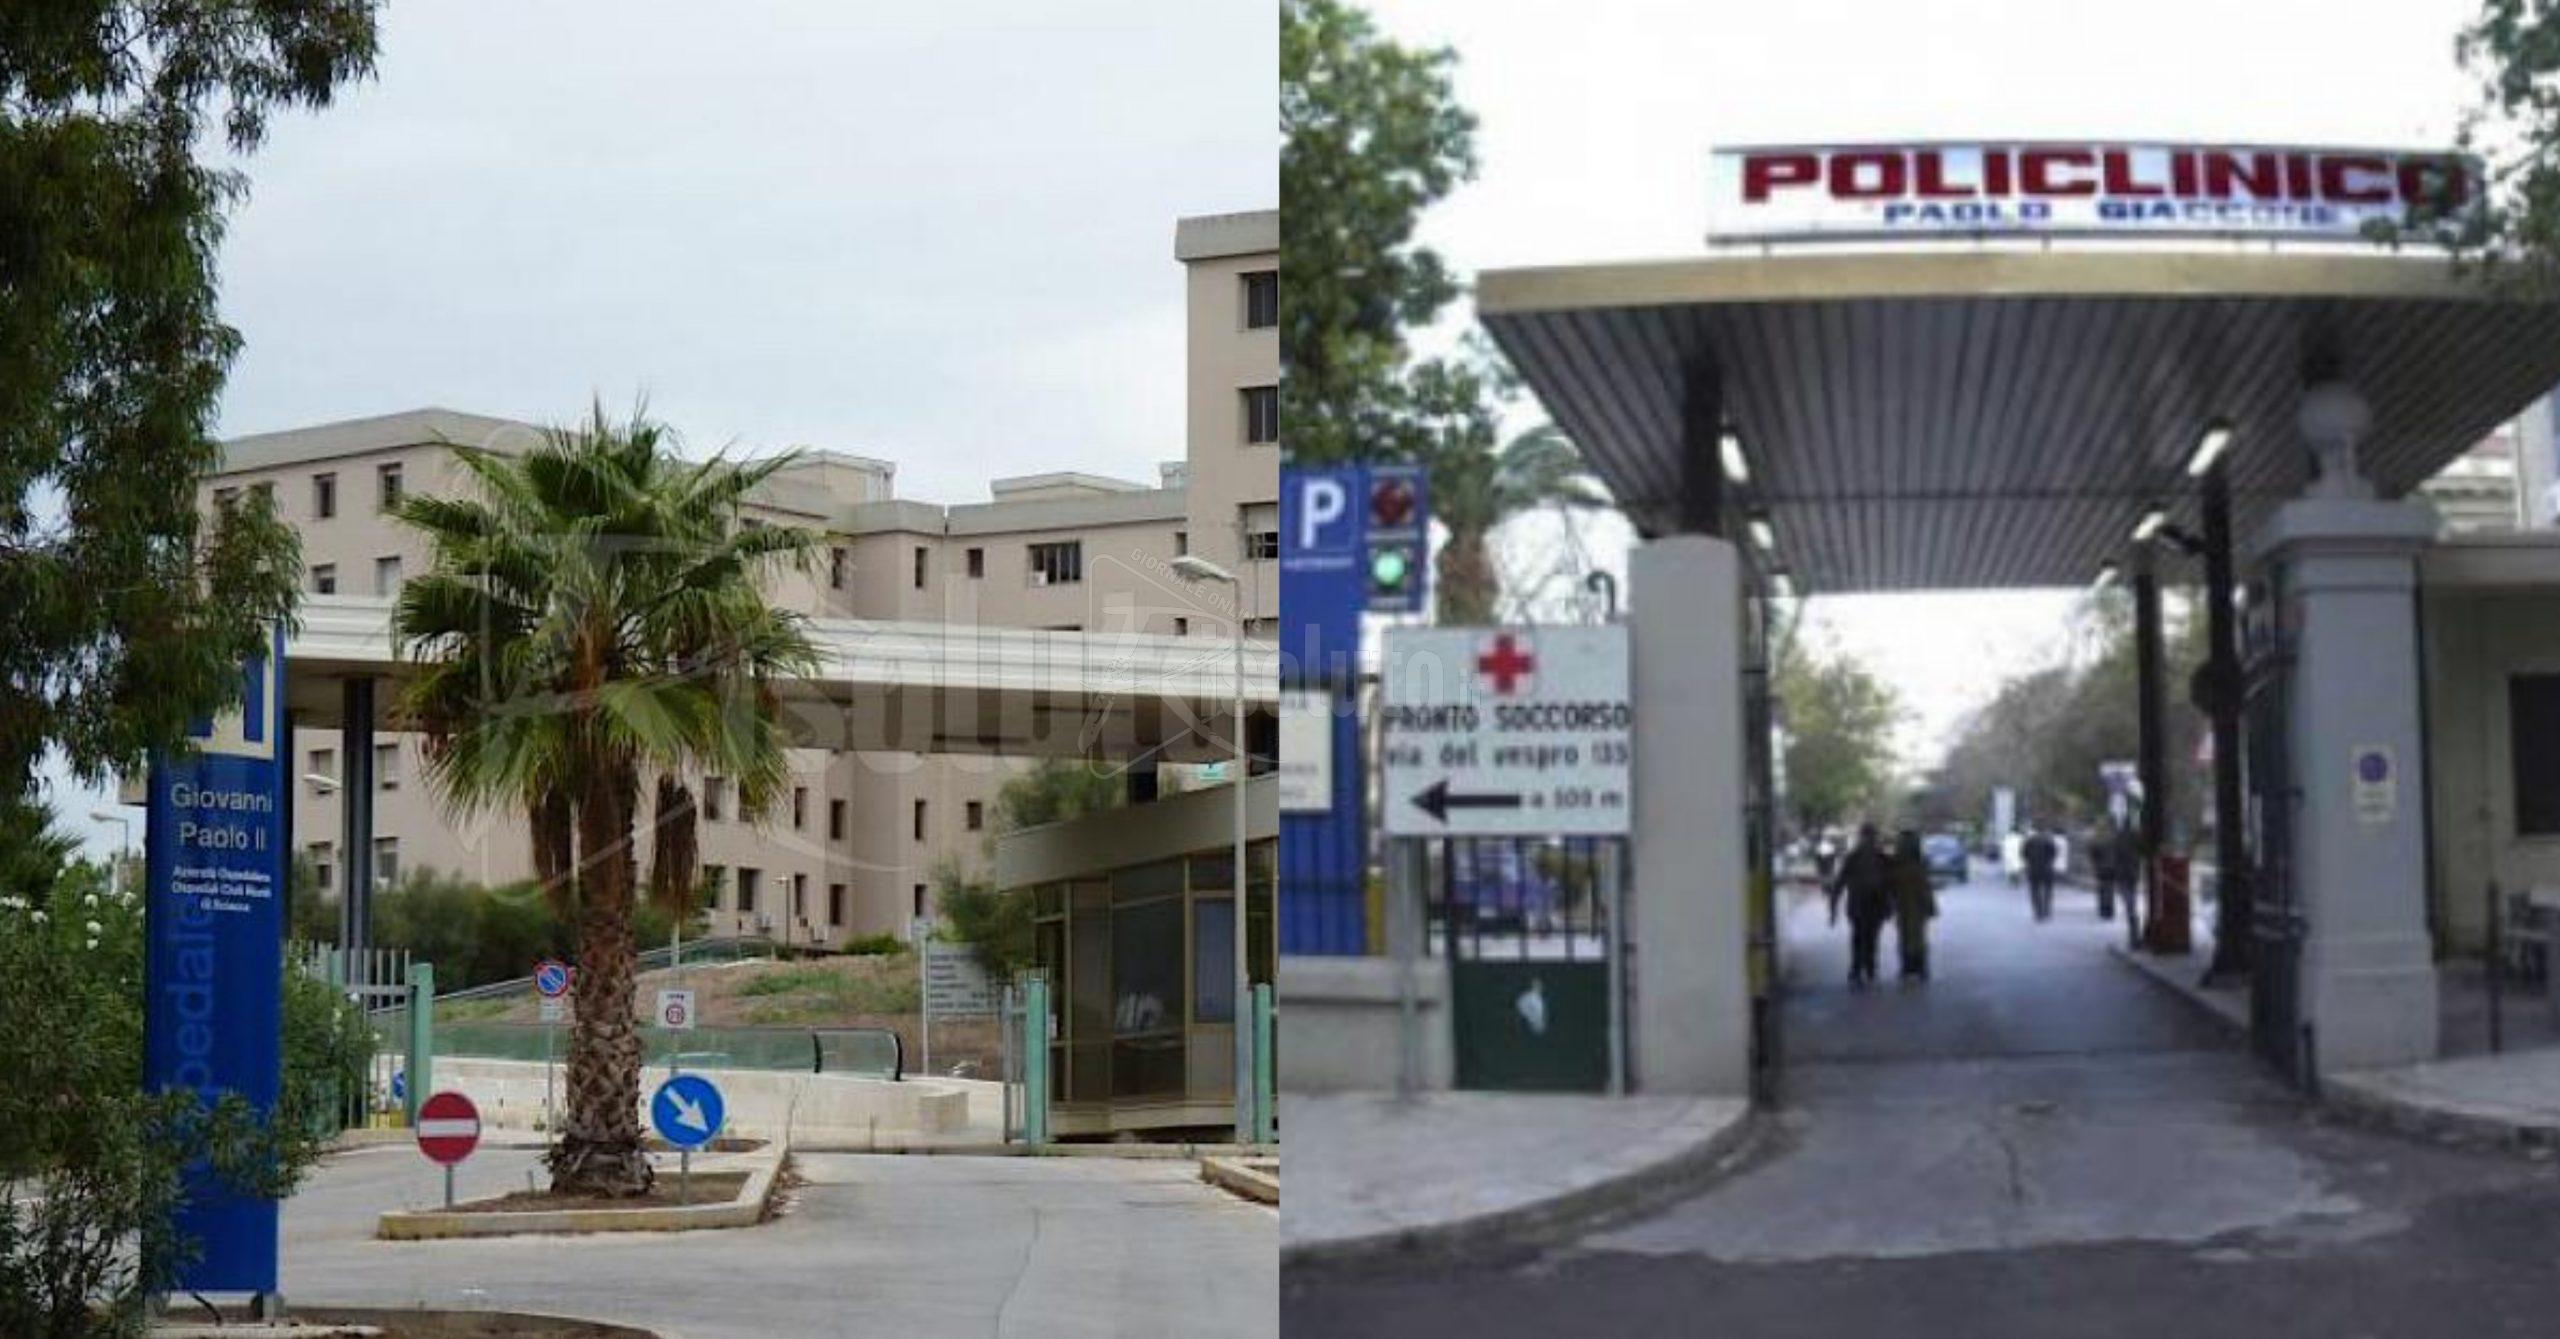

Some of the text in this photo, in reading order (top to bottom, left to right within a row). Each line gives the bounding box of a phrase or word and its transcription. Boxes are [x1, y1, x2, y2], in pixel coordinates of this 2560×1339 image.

[1741, 147, 2470, 205] POLICLINICO
[1883, 202, 2050, 223] PAOLO
[1302, 478, 1346, 549] P
[1383, 703, 1630, 733] PRONTO SOCCORSO
[1439, 740, 1478, 768] del
[170, 782, 273, 813] Giovanni
[180, 821, 248, 850] Paolo
